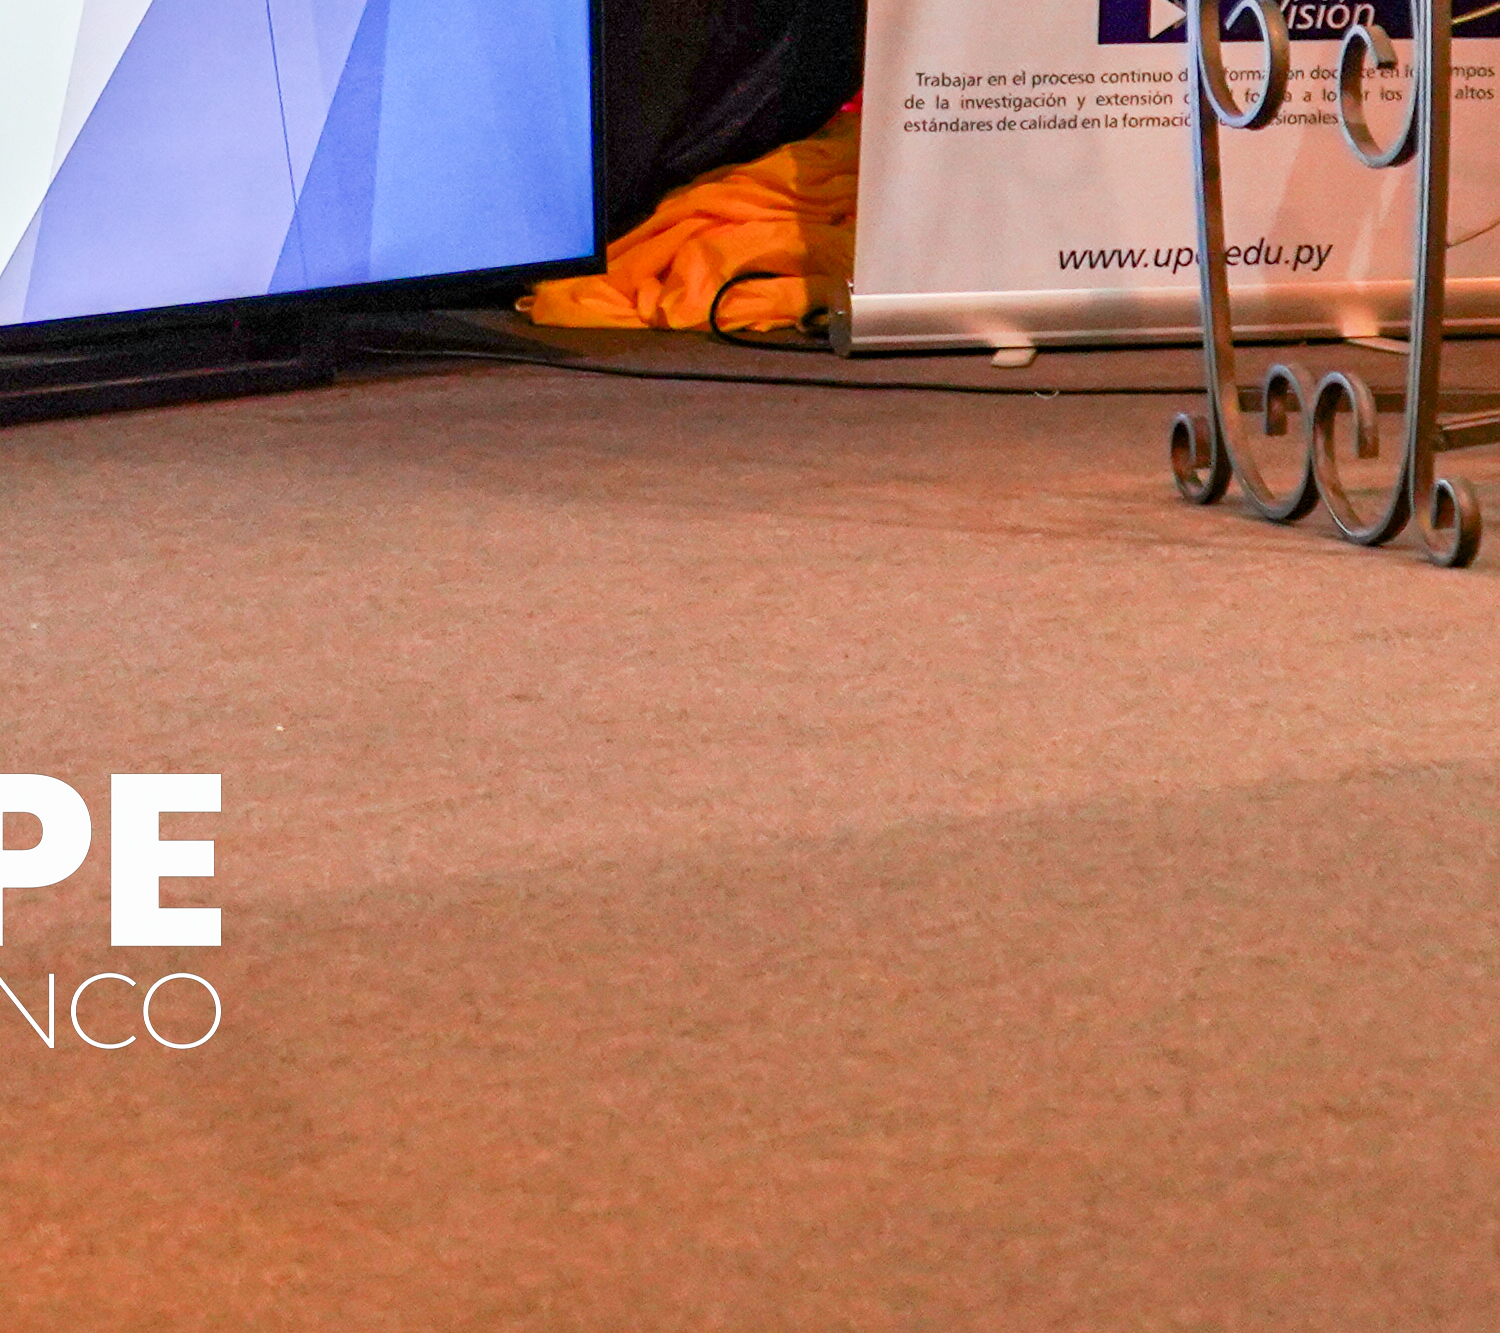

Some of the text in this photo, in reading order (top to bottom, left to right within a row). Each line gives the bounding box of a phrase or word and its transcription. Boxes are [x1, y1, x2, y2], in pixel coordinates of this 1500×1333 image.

[915, 71, 982, 91] Trabajar
[987, 74, 1007, 87] en
[1012, 71, 1026, 86] el
[1031, 72, 1096, 89] proceso
[1101, 69, 1173, 84] continuo
[904, 95, 925, 110] de
[936, 94, 950, 110] la
[960, 91, 1067, 112] investigación
[1077, 95, 1087, 111] y
[1096, 90, 1173, 106] extensión
[1381, 87, 1403, 102] los
[1454, 85, 1495, 100] altos
[903, 114, 993, 132] estándares
[997, 115, 1016, 131] de
[1020, 113, 1077, 130] calidad
[1081, 116, 1101, 130] en
[1105, 113, 1118, 129] la
[1059, 237, 1334, 274] www.upedu.py
